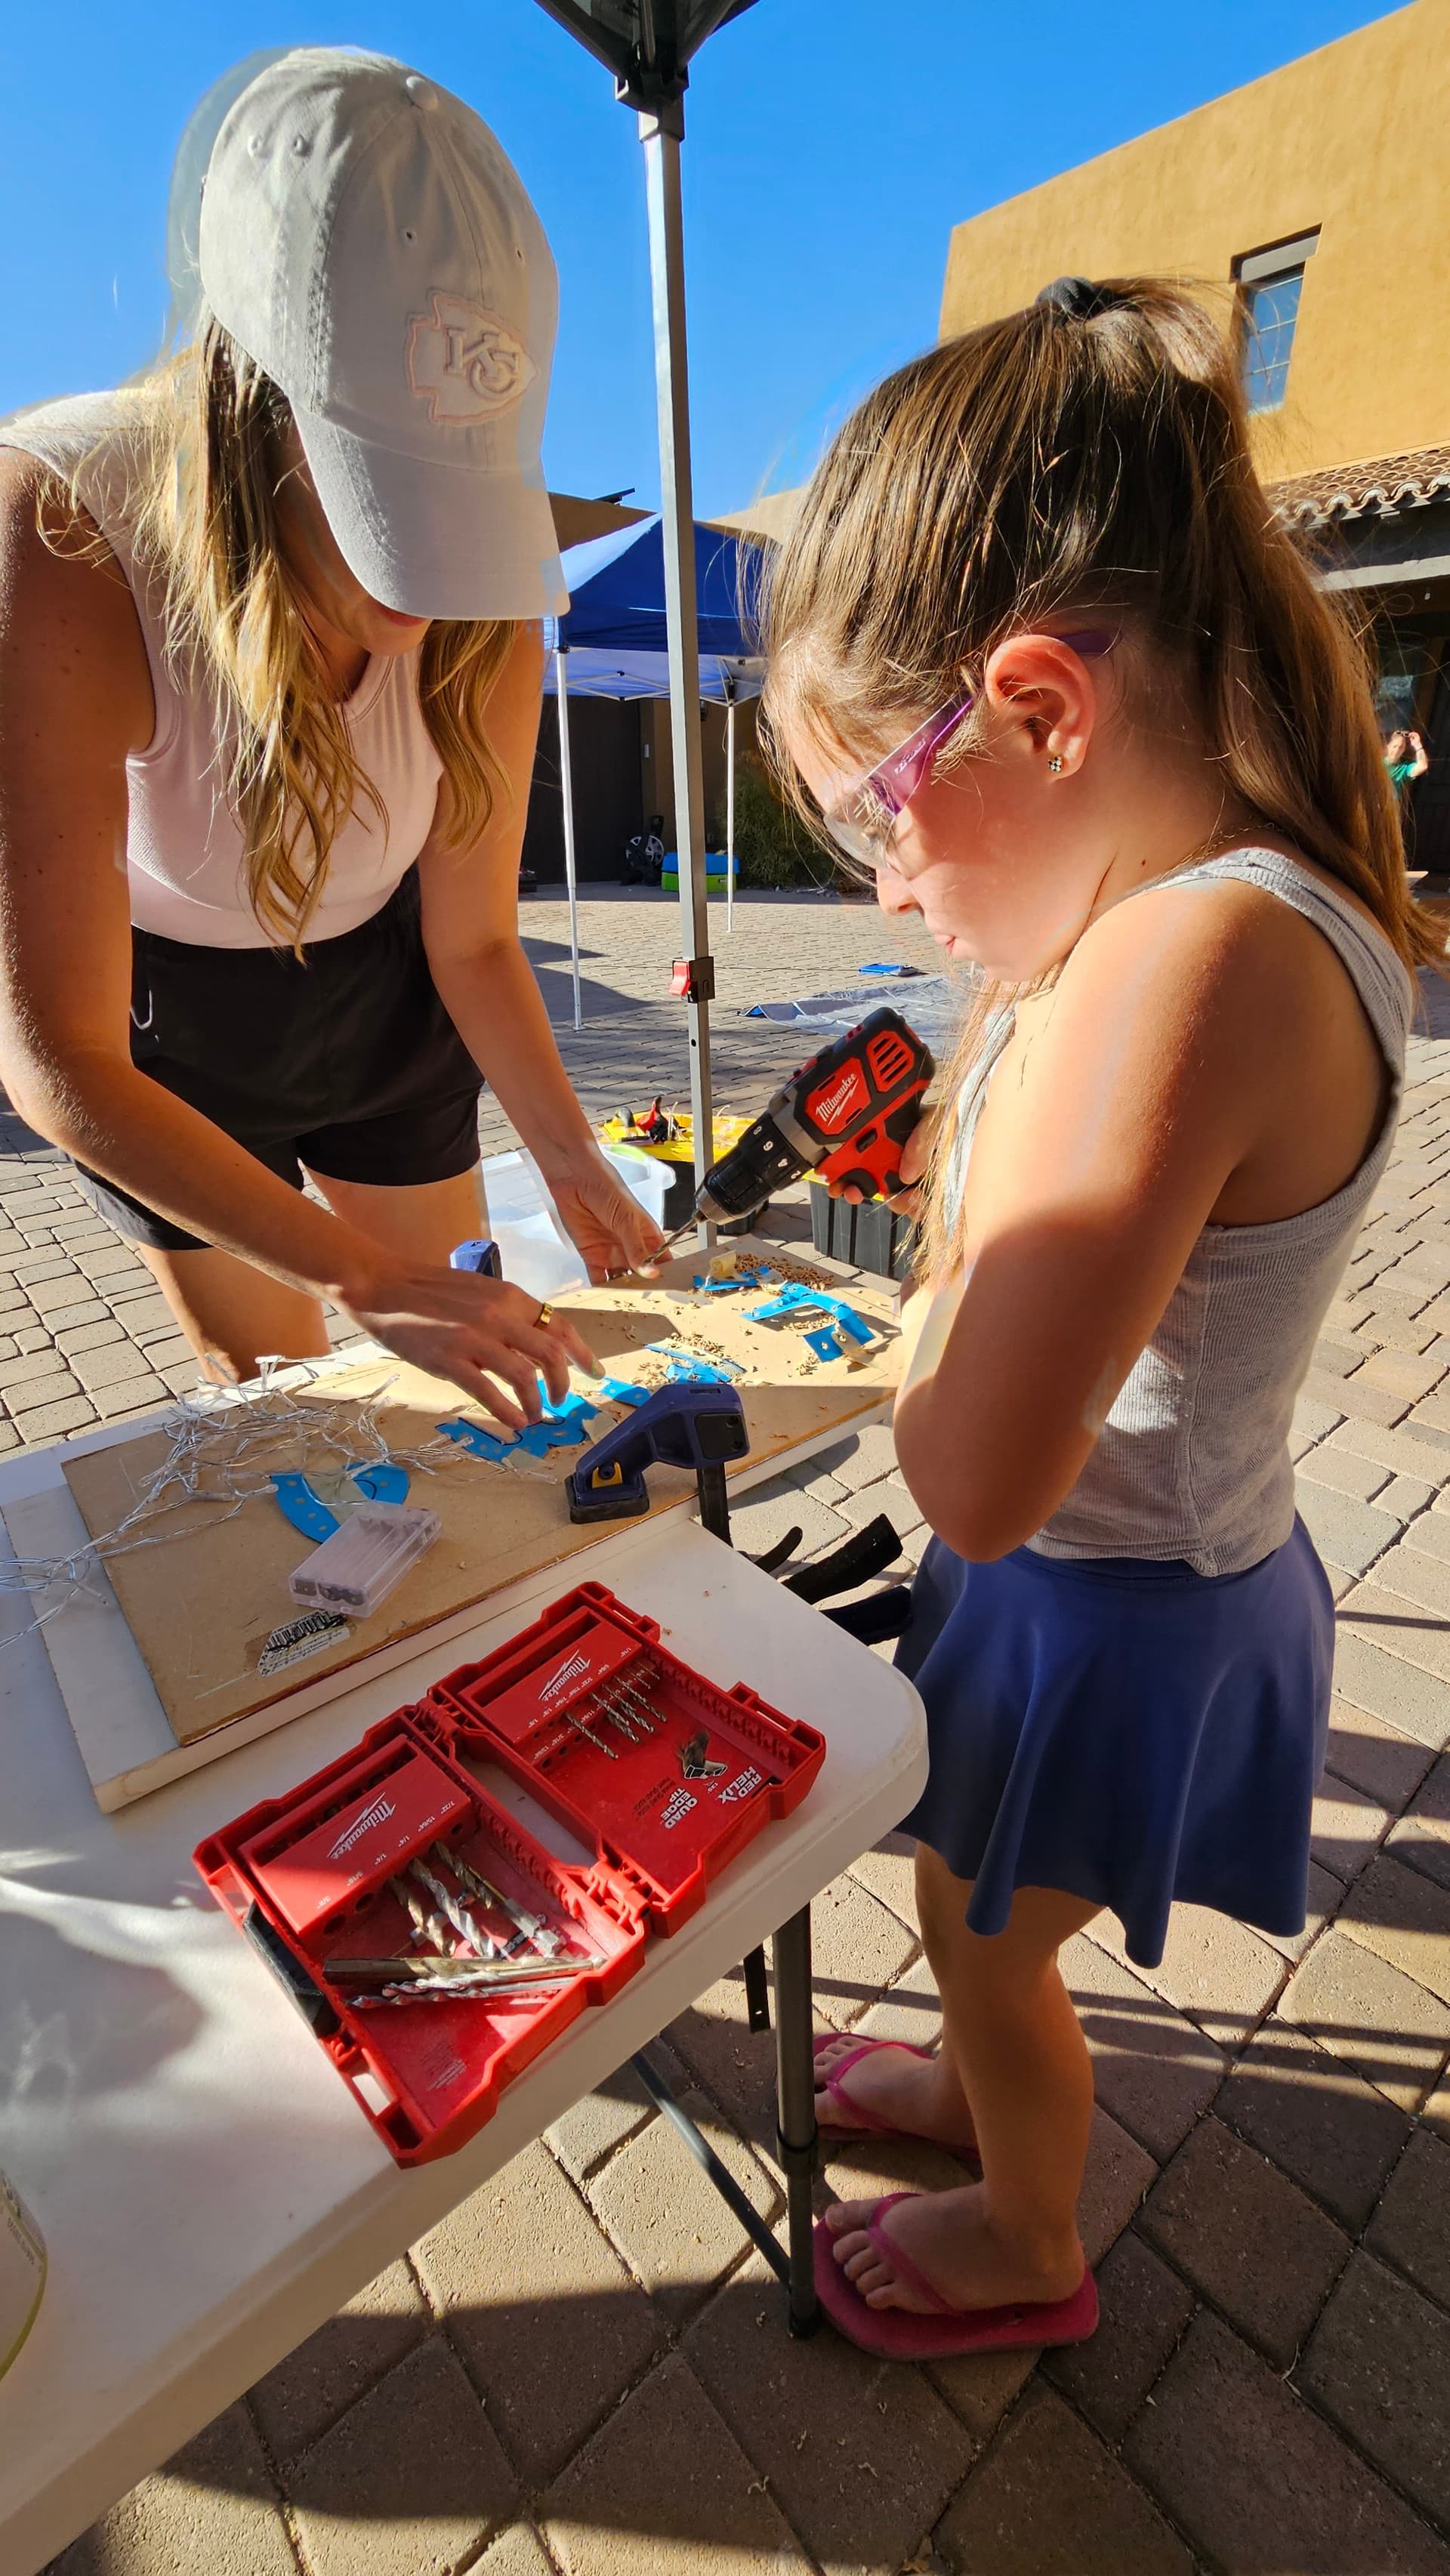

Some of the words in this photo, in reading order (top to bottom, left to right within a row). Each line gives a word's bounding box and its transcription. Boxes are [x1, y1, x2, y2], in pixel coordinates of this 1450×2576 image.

[444, 326, 519, 400] KC
[816, 1073, 857, 1122] Milwaukee
[763, 1141, 774, 1151] 6
[778, 1158, 788, 1167] 4
[791, 1170, 801, 1179] 2
[541, 1656, 591, 1701] Milwaukee
[669, 1787, 686, 1802] TIP
[717, 1765, 756, 1805] HELIX
[738, 1774, 762, 1798] RED
[660, 1791, 691, 1821] EDGE
[664, 1797, 698, 1829] QUAD
[330, 1800, 396, 1860] Milwaukee
